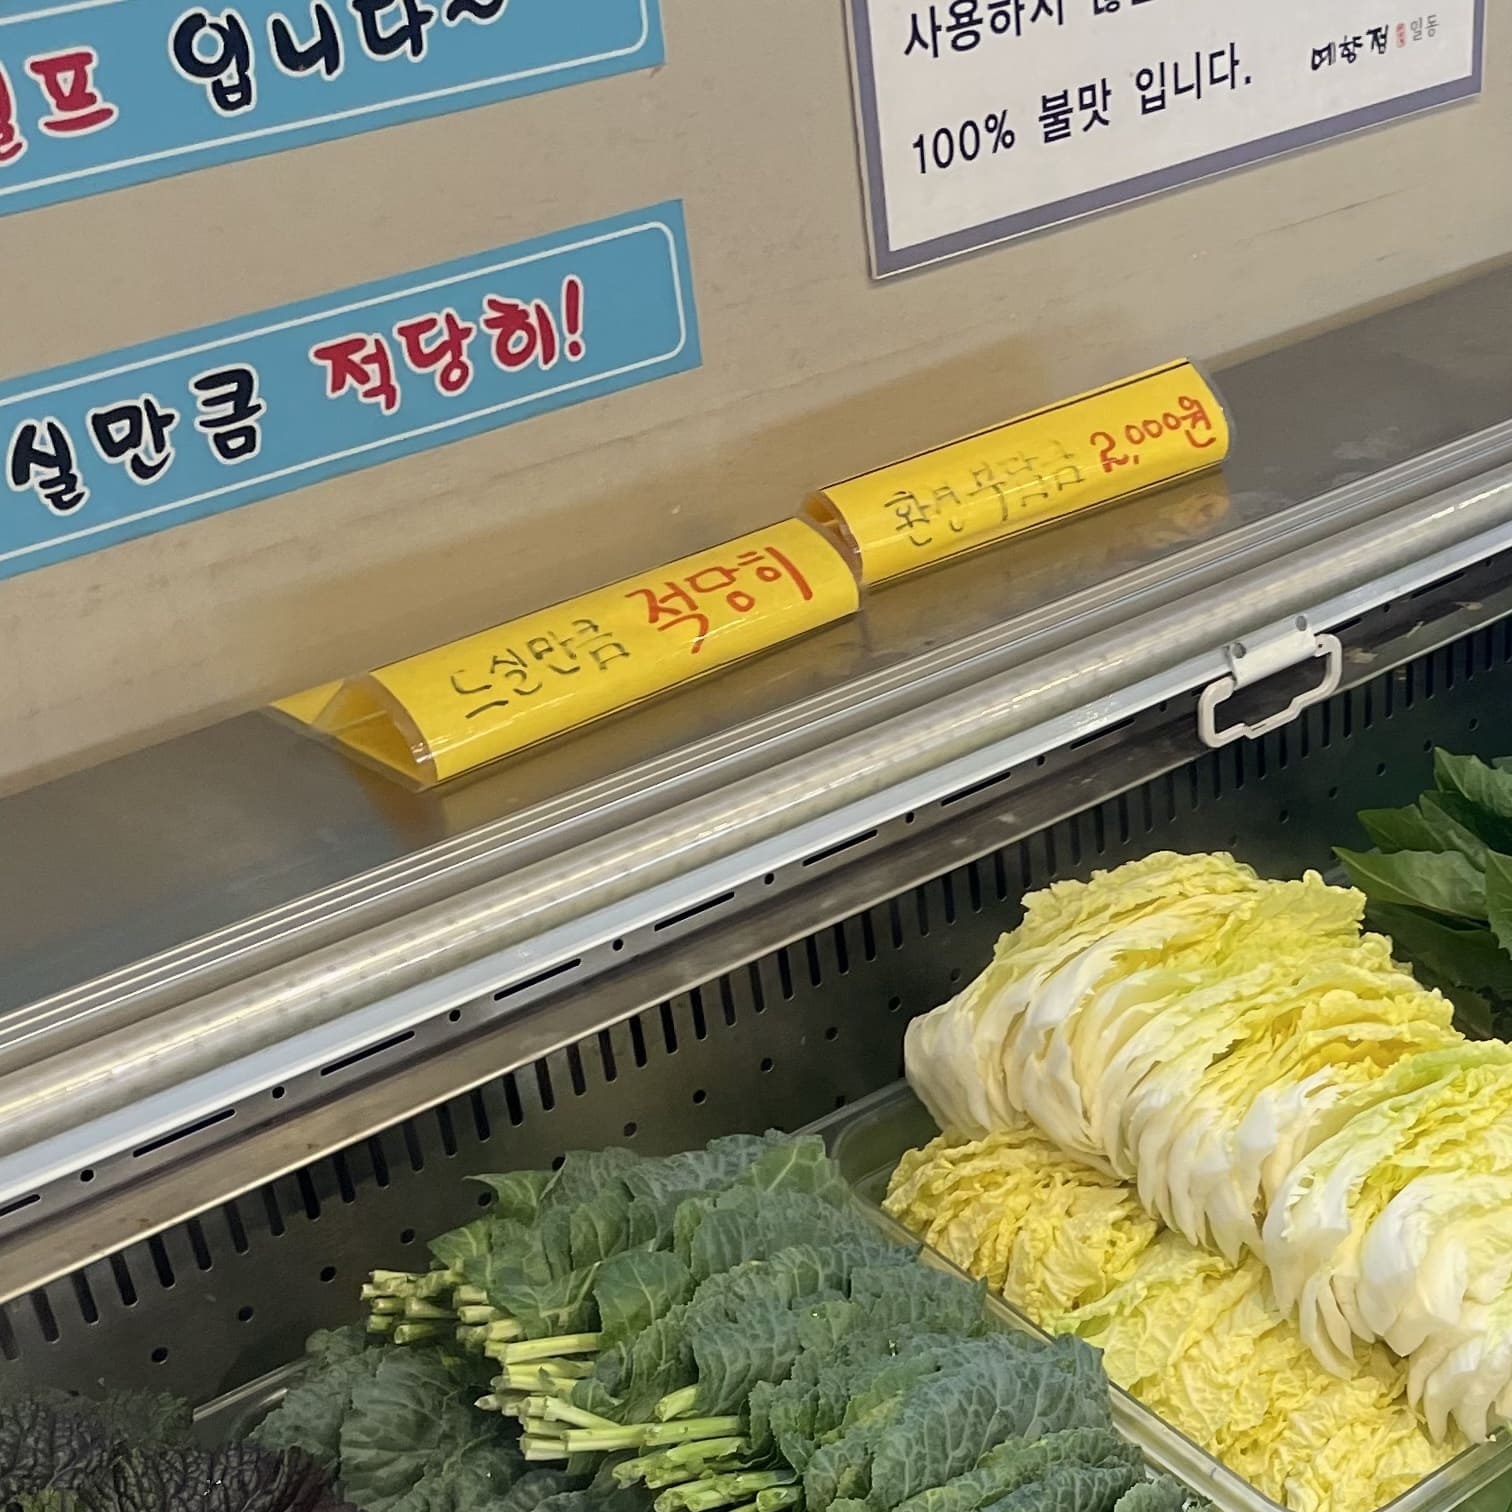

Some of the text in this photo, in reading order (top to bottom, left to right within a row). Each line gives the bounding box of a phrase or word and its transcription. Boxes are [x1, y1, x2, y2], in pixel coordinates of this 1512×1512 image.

[1410, 14, 1440, 42] 일동
[911, 42, 1252, 174] 100% 불맛 입니다.
[313, 278, 582, 410] 적당히!
[1089, 395, 1217, 473] 2,000원
